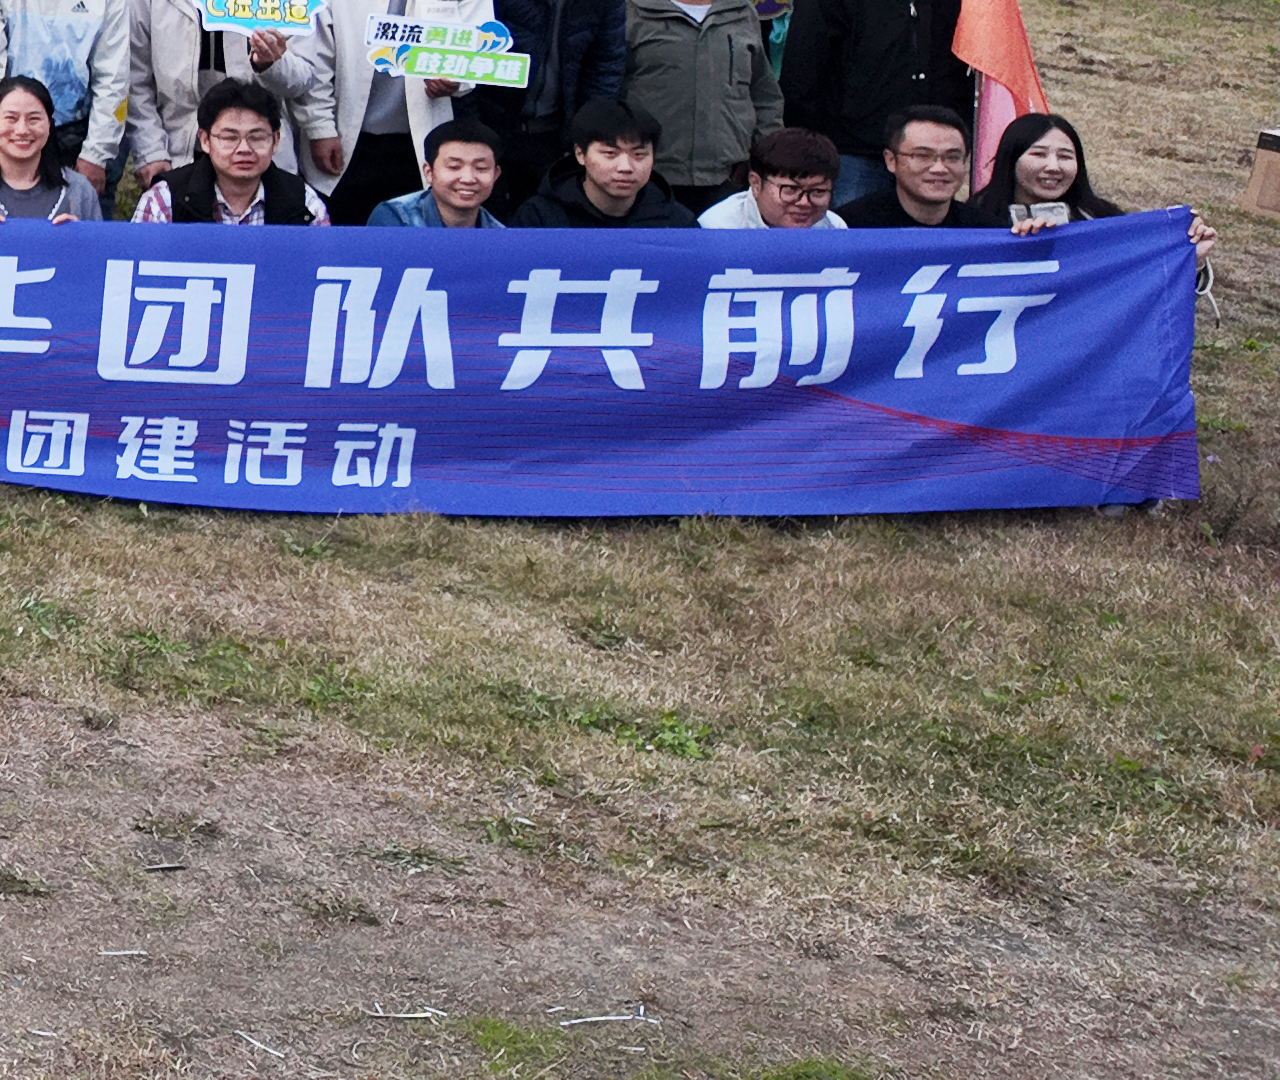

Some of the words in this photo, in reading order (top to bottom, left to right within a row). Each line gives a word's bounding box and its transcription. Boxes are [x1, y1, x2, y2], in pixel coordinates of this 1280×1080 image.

[374, 21, 474, 49] 激流勇进
[413, 51, 523, 81] 鼓劲争雄
